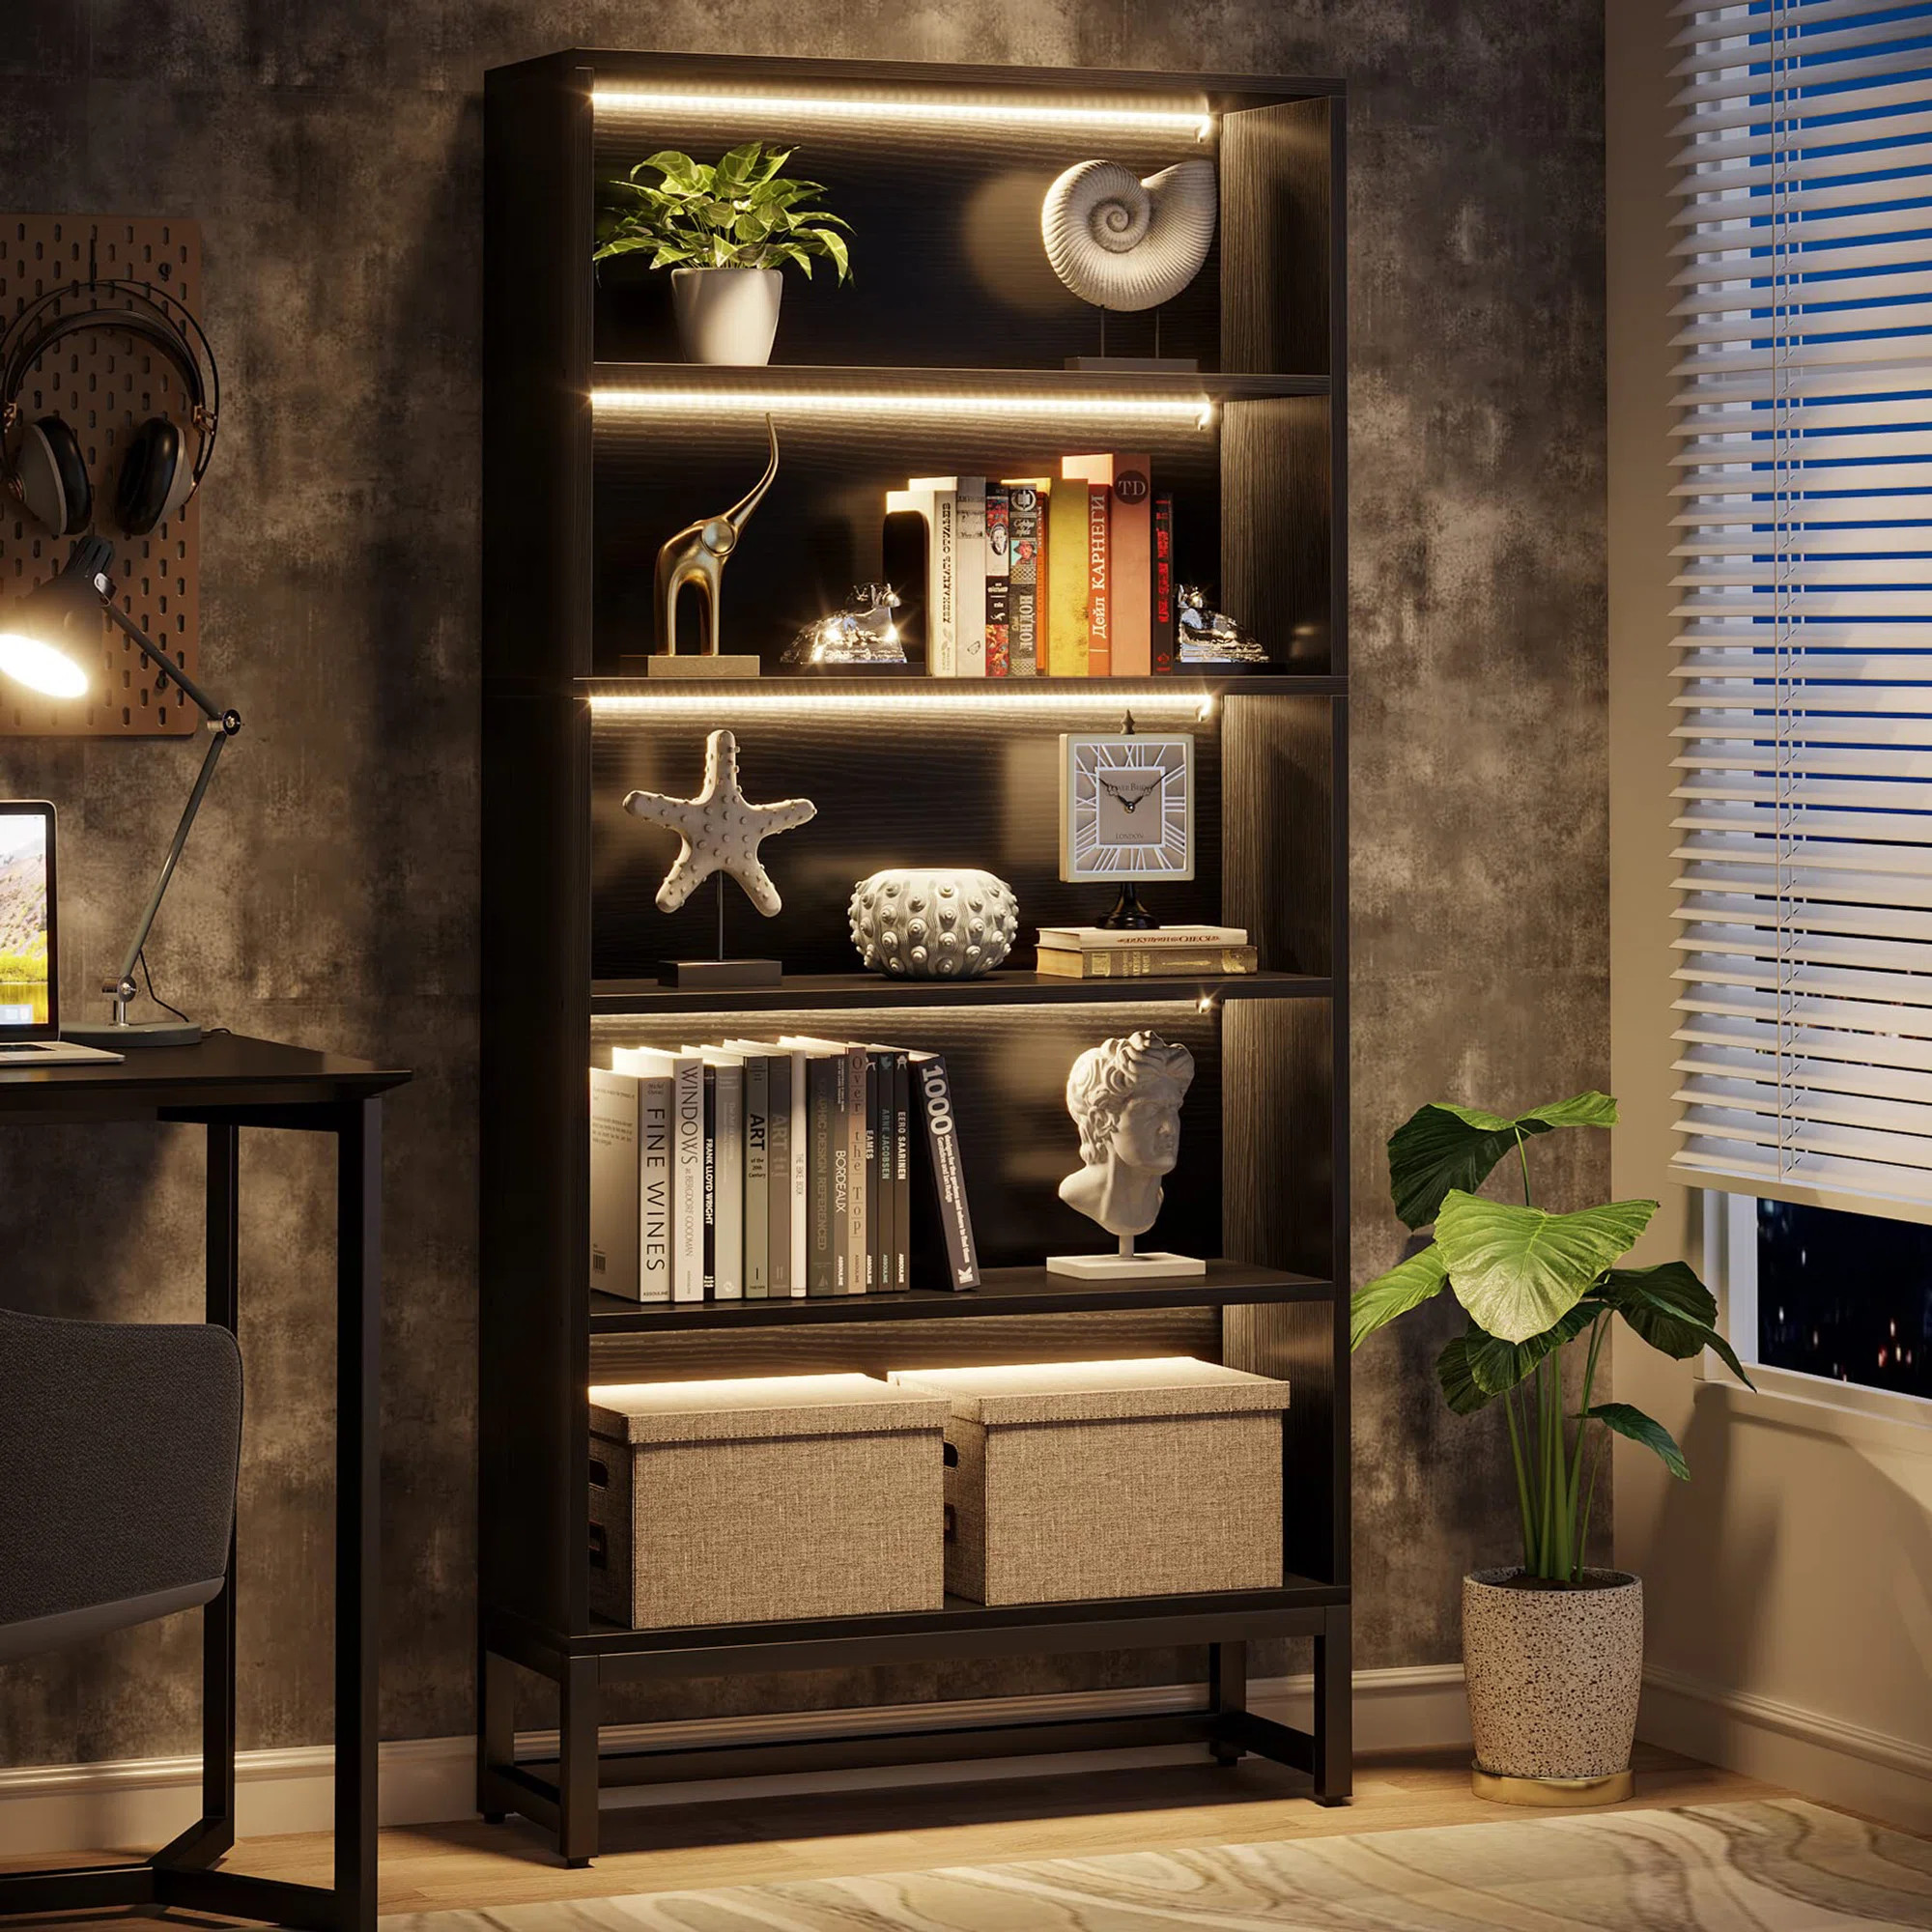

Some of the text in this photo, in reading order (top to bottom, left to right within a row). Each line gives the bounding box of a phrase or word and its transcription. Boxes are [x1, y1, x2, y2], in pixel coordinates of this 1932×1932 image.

[1118, 480, 1146, 496] TD
[1091, 495, 1107, 639] Дейл КАРНЕГИ
[1019, 594, 1036, 651] ЛОНДОН
[852, 1056, 863, 1112] Over
[922, 1065, 952, 1135] 1000
[681, 1065, 698, 1165] WINDOWS
[750, 1113, 765, 1151] ART
[772, 1114, 789, 1150] ART
[817, 1132, 828, 1174] DESIGN
[853, 1131, 862, 1171] the
[866, 1129, 874, 1159] EAMES
[881, 1109, 891, 1179] ARNE JACOBSEN
[897, 1111, 906, 1180] EERO SAARINEN
[646, 1108, 666, 1270] FINE WINES
[685, 1176, 695, 1213] BERGDORF
[705, 1138, 714, 1225] FRANK LLOYD WRIGHT
[835, 1150, 846, 1212] BORDEAUX
[685, 1215, 695, 1257] GOODMAN
[816, 1177, 828, 1250] REFERENCED
